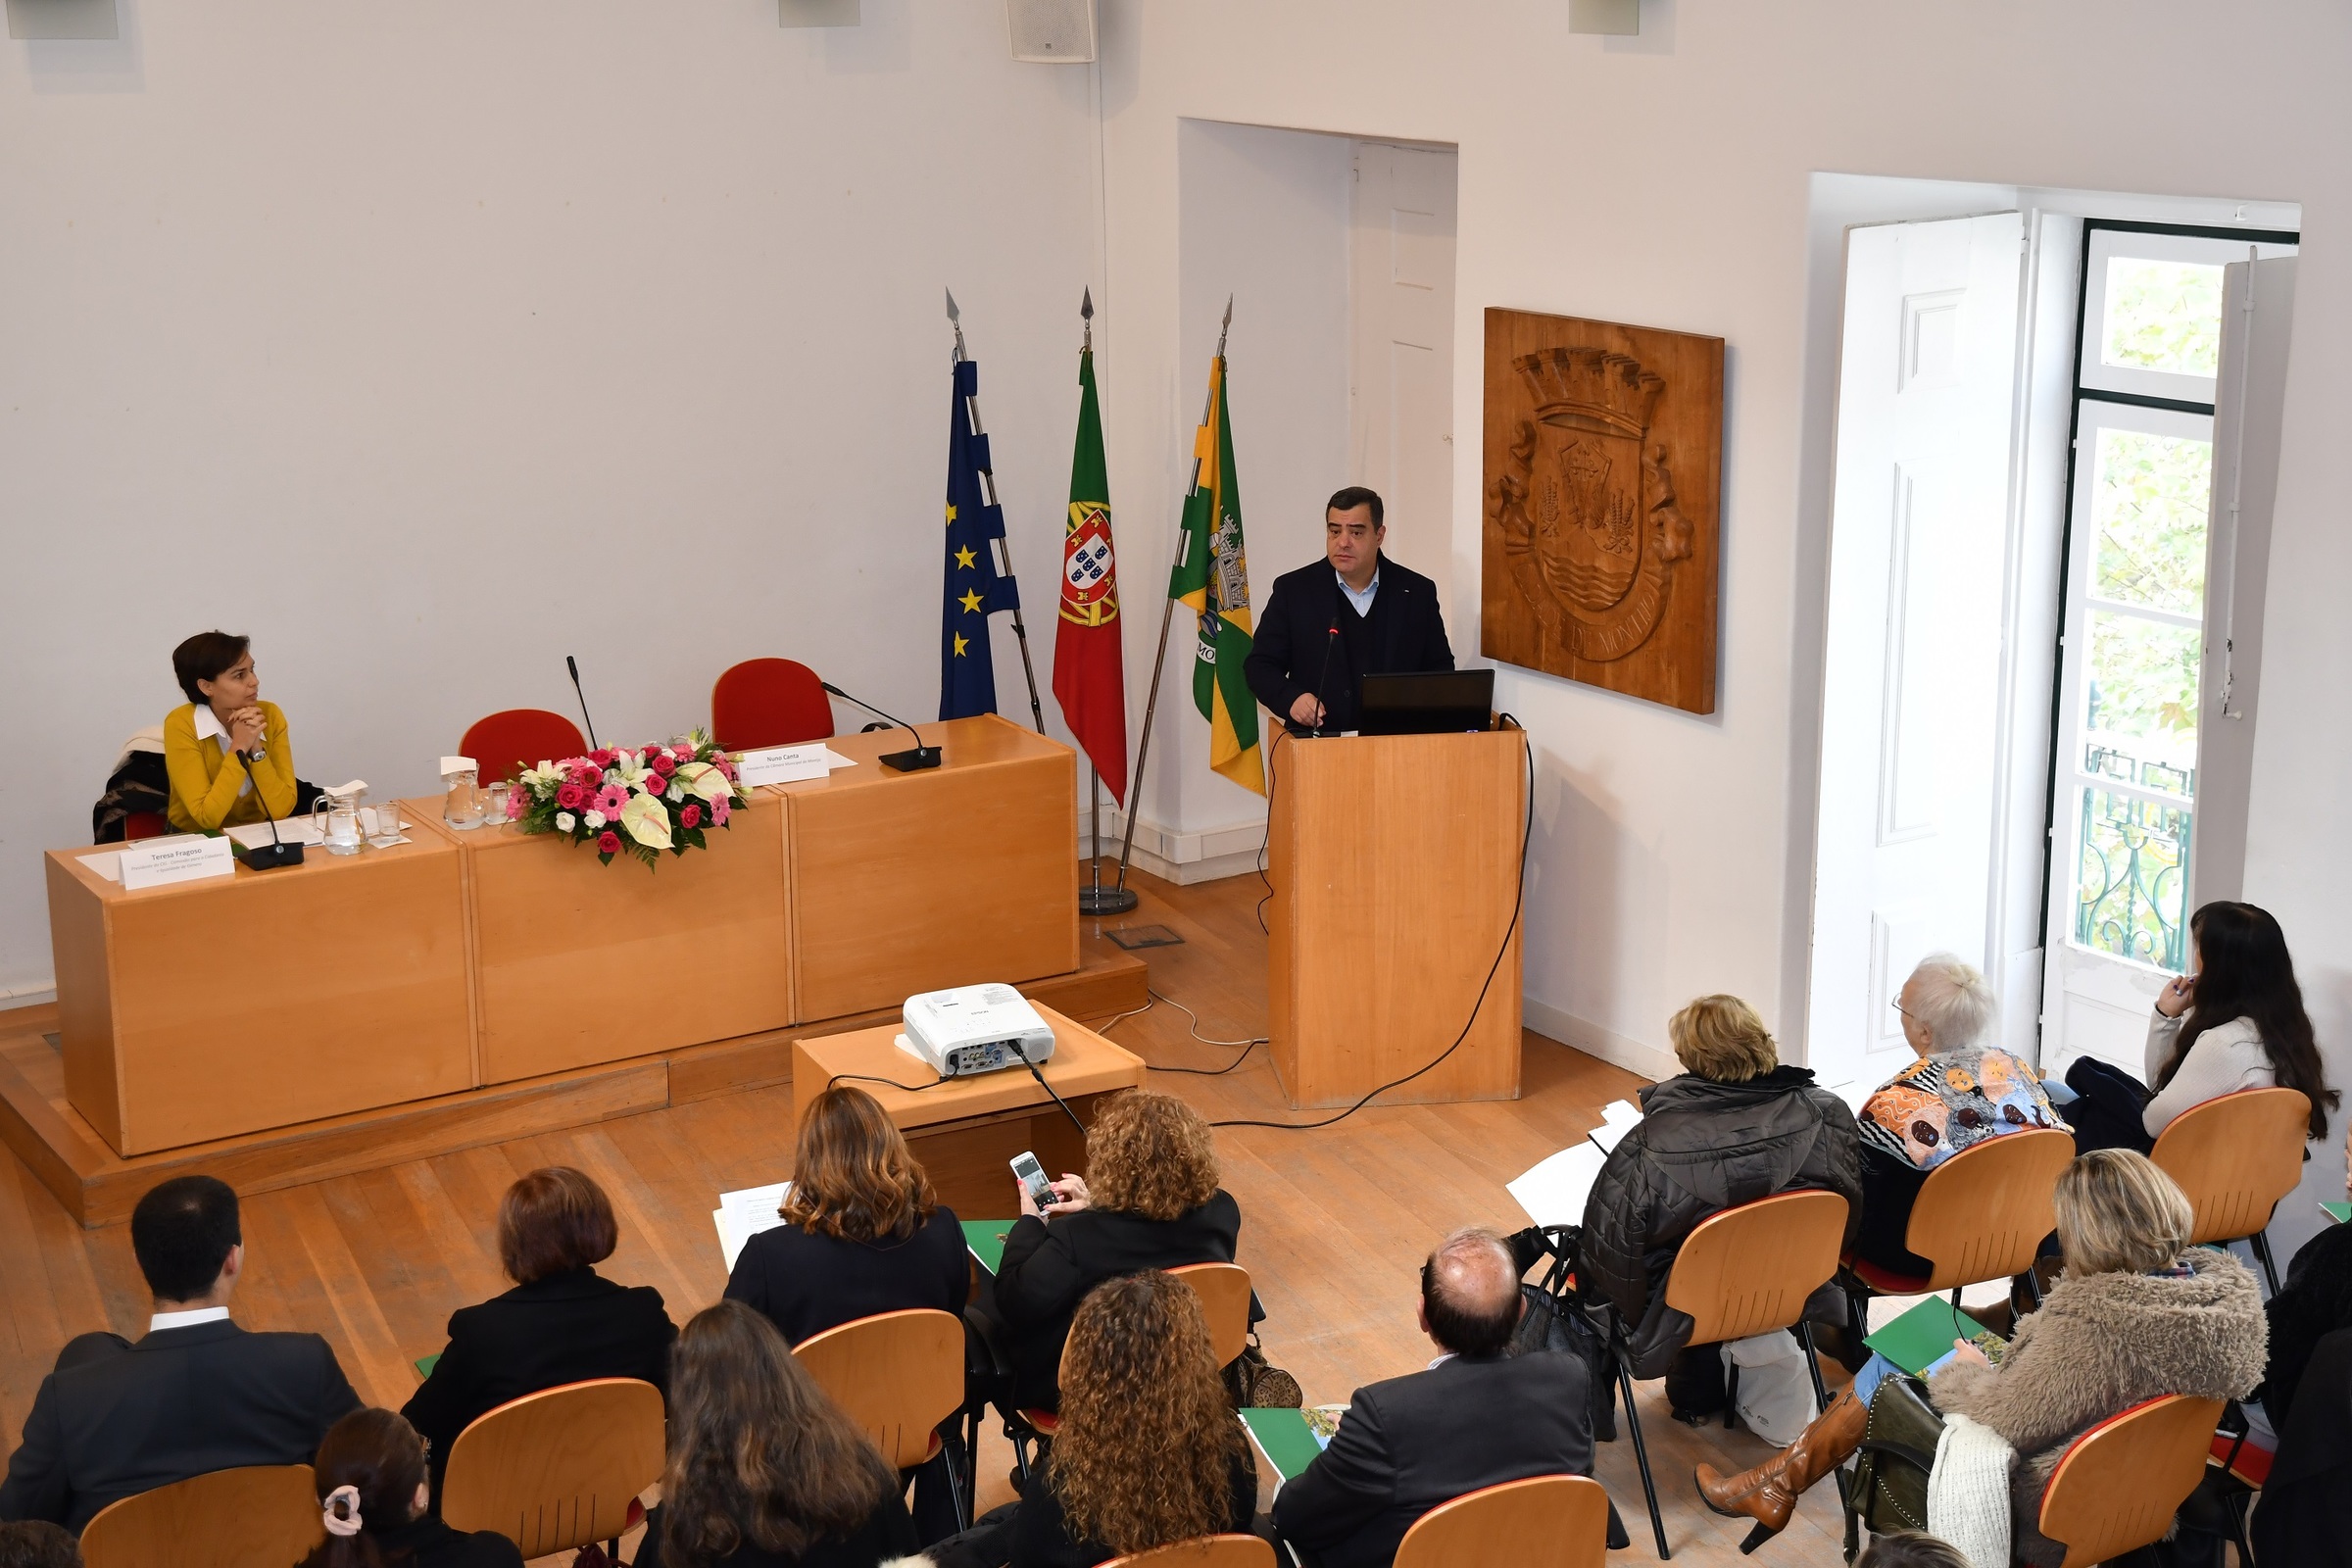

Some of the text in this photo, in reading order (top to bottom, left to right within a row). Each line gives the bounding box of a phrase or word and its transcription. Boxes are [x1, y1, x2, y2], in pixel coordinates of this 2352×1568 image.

[1571, 624, 1592, 656] DE
[1598, 593, 1655, 655] MONTIJO
[175, 848, 203, 857] Fragoso
